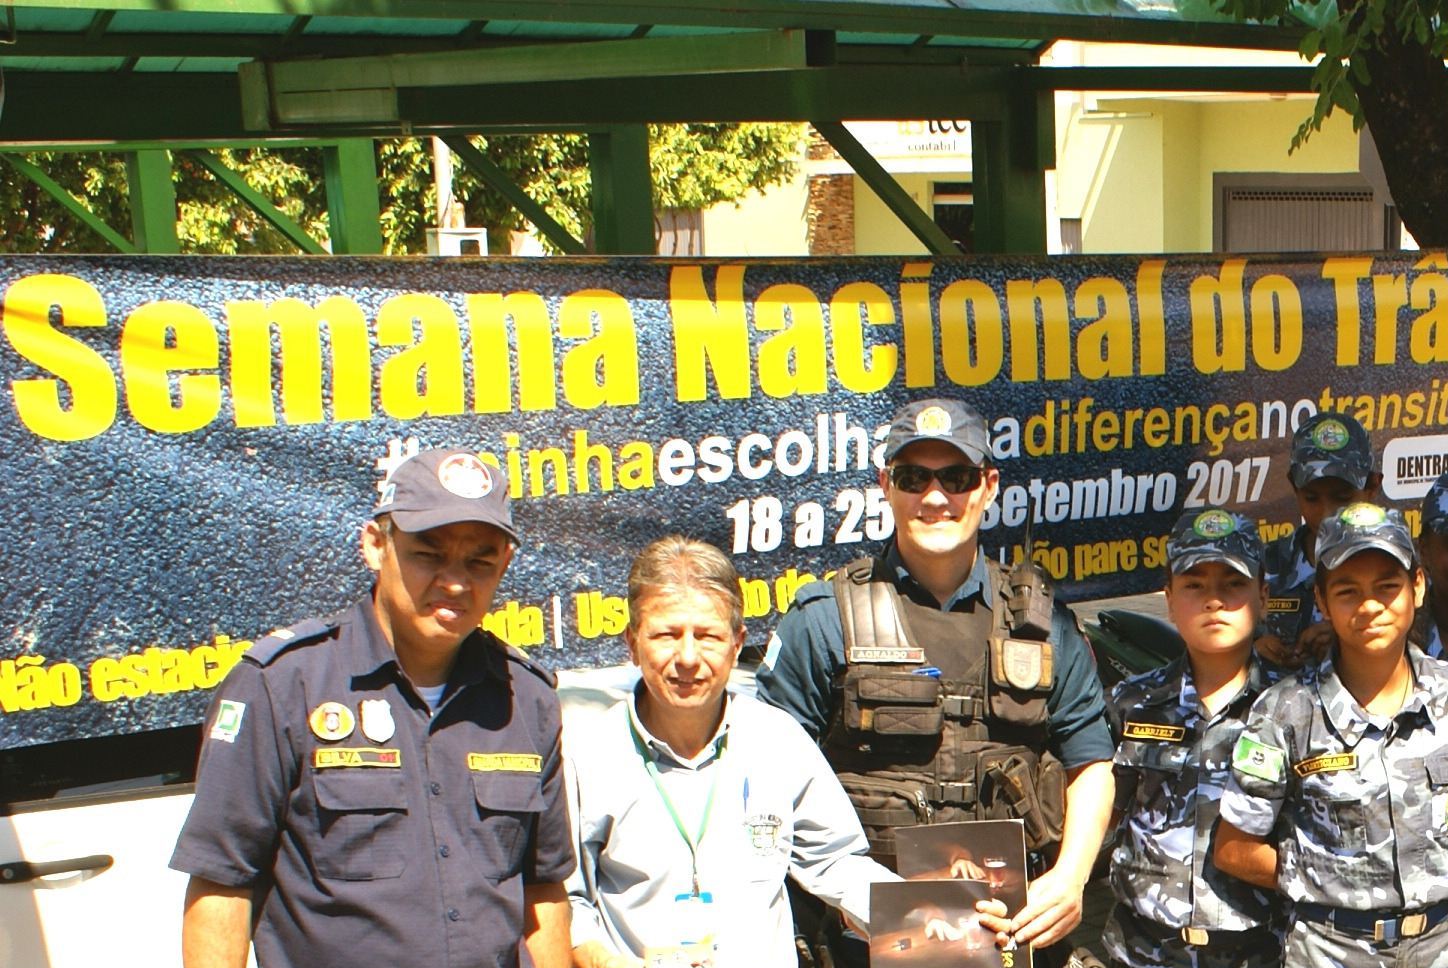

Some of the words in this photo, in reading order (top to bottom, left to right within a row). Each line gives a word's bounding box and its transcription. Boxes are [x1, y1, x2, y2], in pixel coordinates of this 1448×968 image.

[2, 273, 640, 441] Semana
[670, 260, 1166, 402] Nacional
[1190, 259, 1303, 374] do
[726, 495, 783, 554] 18
[795, 502, 825, 548] a
[835, 488, 895, 544] 25
[1184, 456, 1271, 509] 2017
[1074, 539, 1137, 581] pare
[1133, 727, 1175, 737] GABRIELY
